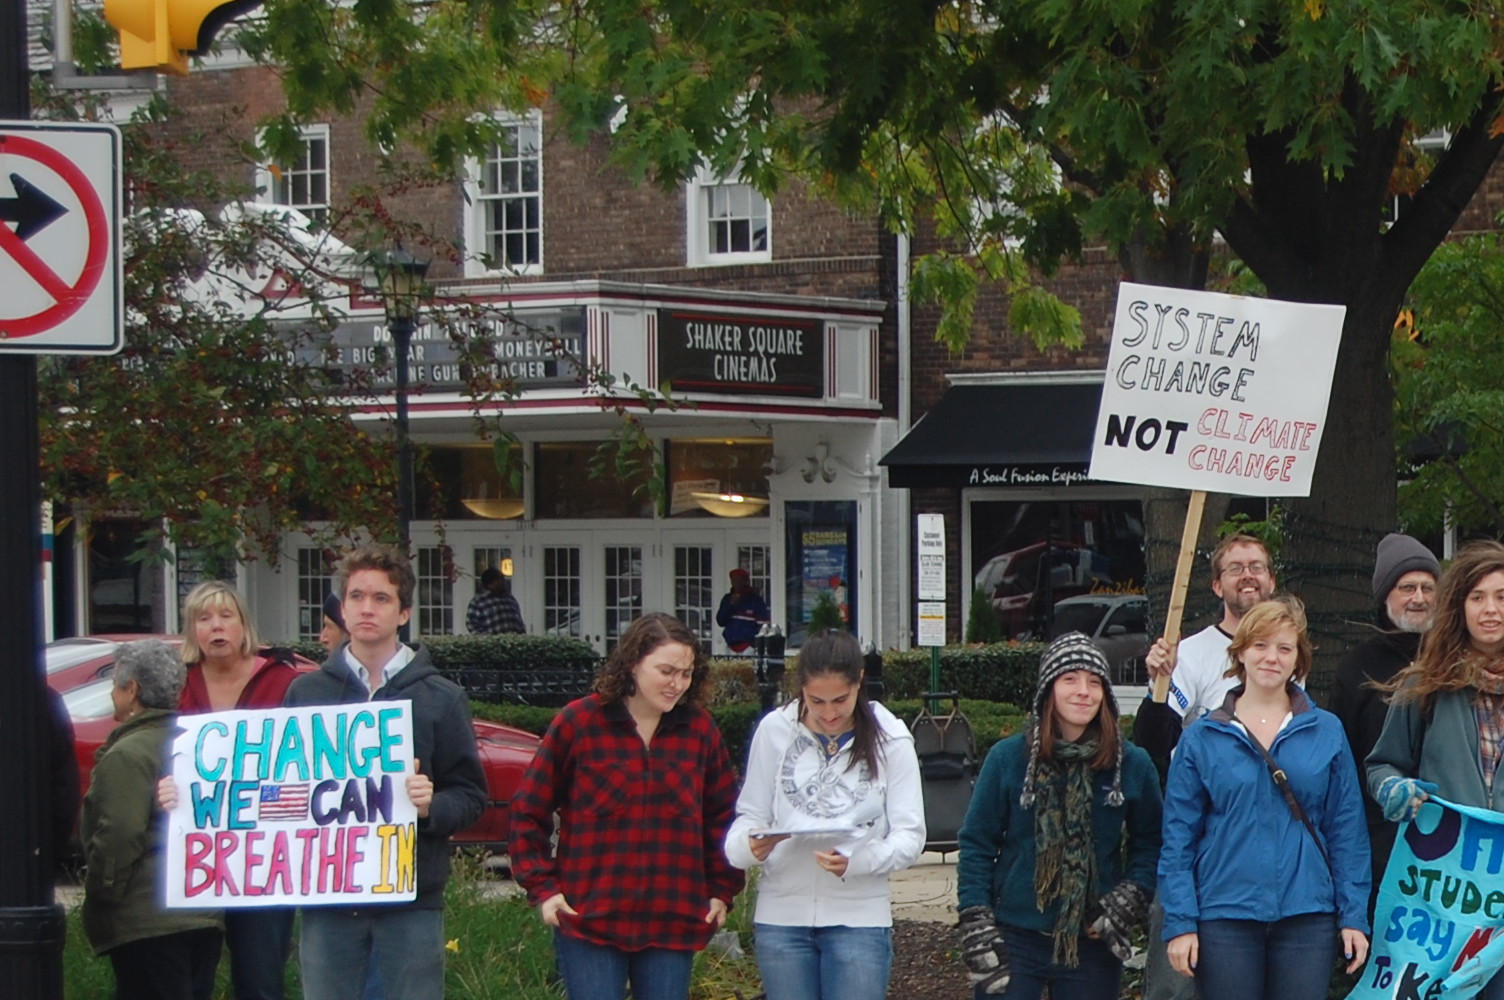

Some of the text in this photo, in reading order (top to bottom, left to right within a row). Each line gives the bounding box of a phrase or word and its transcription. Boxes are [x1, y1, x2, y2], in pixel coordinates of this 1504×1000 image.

[686, 322, 804, 358] SHAKER SQUARE
[1122, 301, 1260, 361] SYSTEM
[353, 350, 376, 363] BIG
[388, 345, 424, 362] YAR
[433, 365, 460, 381] GUN
[714, 354, 777, 383] CINEMAS
[1116, 355, 1254, 402] CHANGE
[1104, 408, 1317, 454] NOT CLIMATE
[969, 468, 979, 483] A
[982, 467, 1008, 483] Soul
[1011, 467, 1050, 484] Fusion
[1188, 445, 1296, 482] CHANGE
[195, 708, 405, 782] CHANGE
[190, 775, 394, 830] WE CAN
[185, 822, 416, 898] BREATHE IN
[1384, 906, 1455, 962] say
[1371, 956, 1394, 989] To
